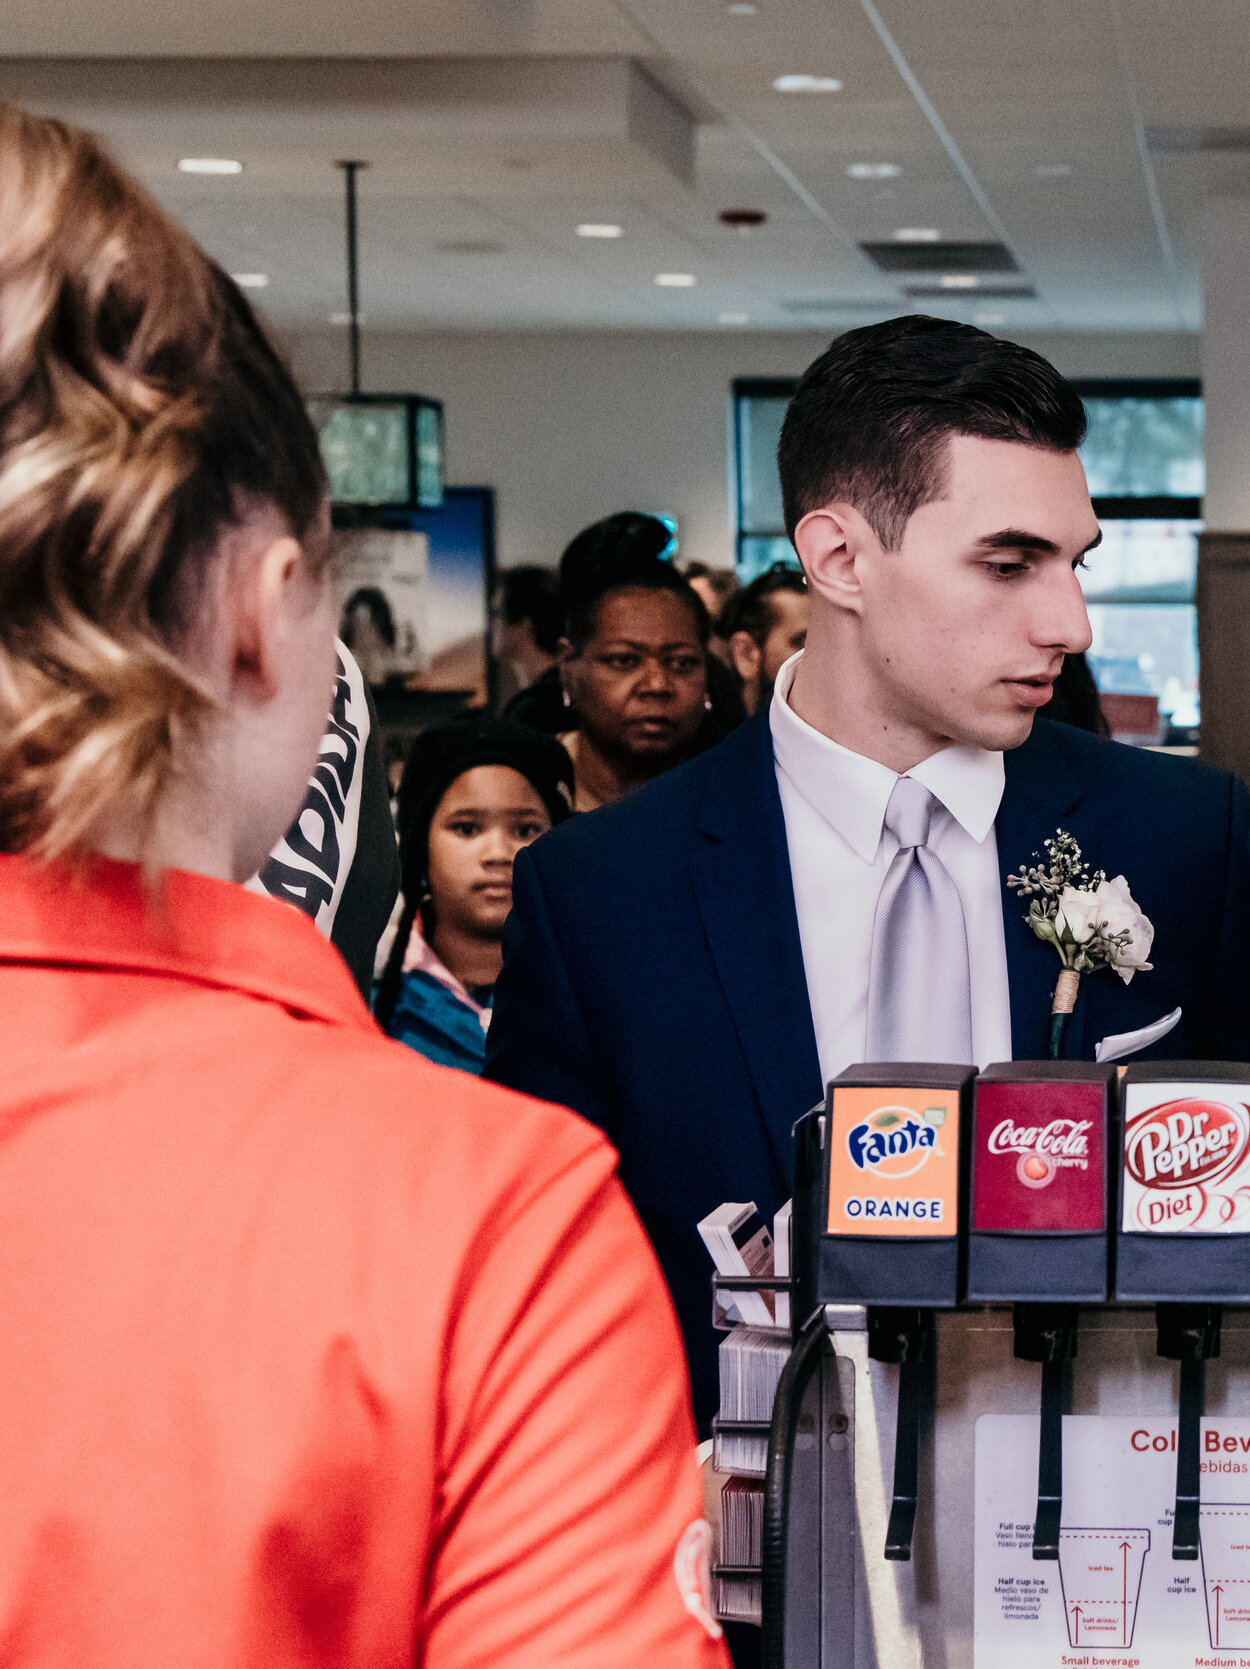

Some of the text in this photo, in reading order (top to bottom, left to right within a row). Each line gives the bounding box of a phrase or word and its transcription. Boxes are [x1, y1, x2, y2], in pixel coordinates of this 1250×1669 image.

[988, 1119, 1093, 1155] Coca-Cola
[1167, 1112, 1209, 1146] Dr
[848, 1120, 936, 1169] Fanta
[1138, 1122, 1237, 1181] Pepper
[1051, 1156, 1088, 1170] cherry
[847, 1199, 941, 1218] ORANGE
[1149, 1193, 1193, 1225] Diet
[1131, 1430, 1177, 1452] Col
[1200, 1460, 1248, 1474] ebidas
[1016, 1524, 1031, 1532] cup
[1019, 1541, 1033, 1549] par
[1016, 1579, 1031, 1587] cup
[1061, 1656, 1140, 1668] Small beverage
[1195, 1658, 1237, 1667] Medium
